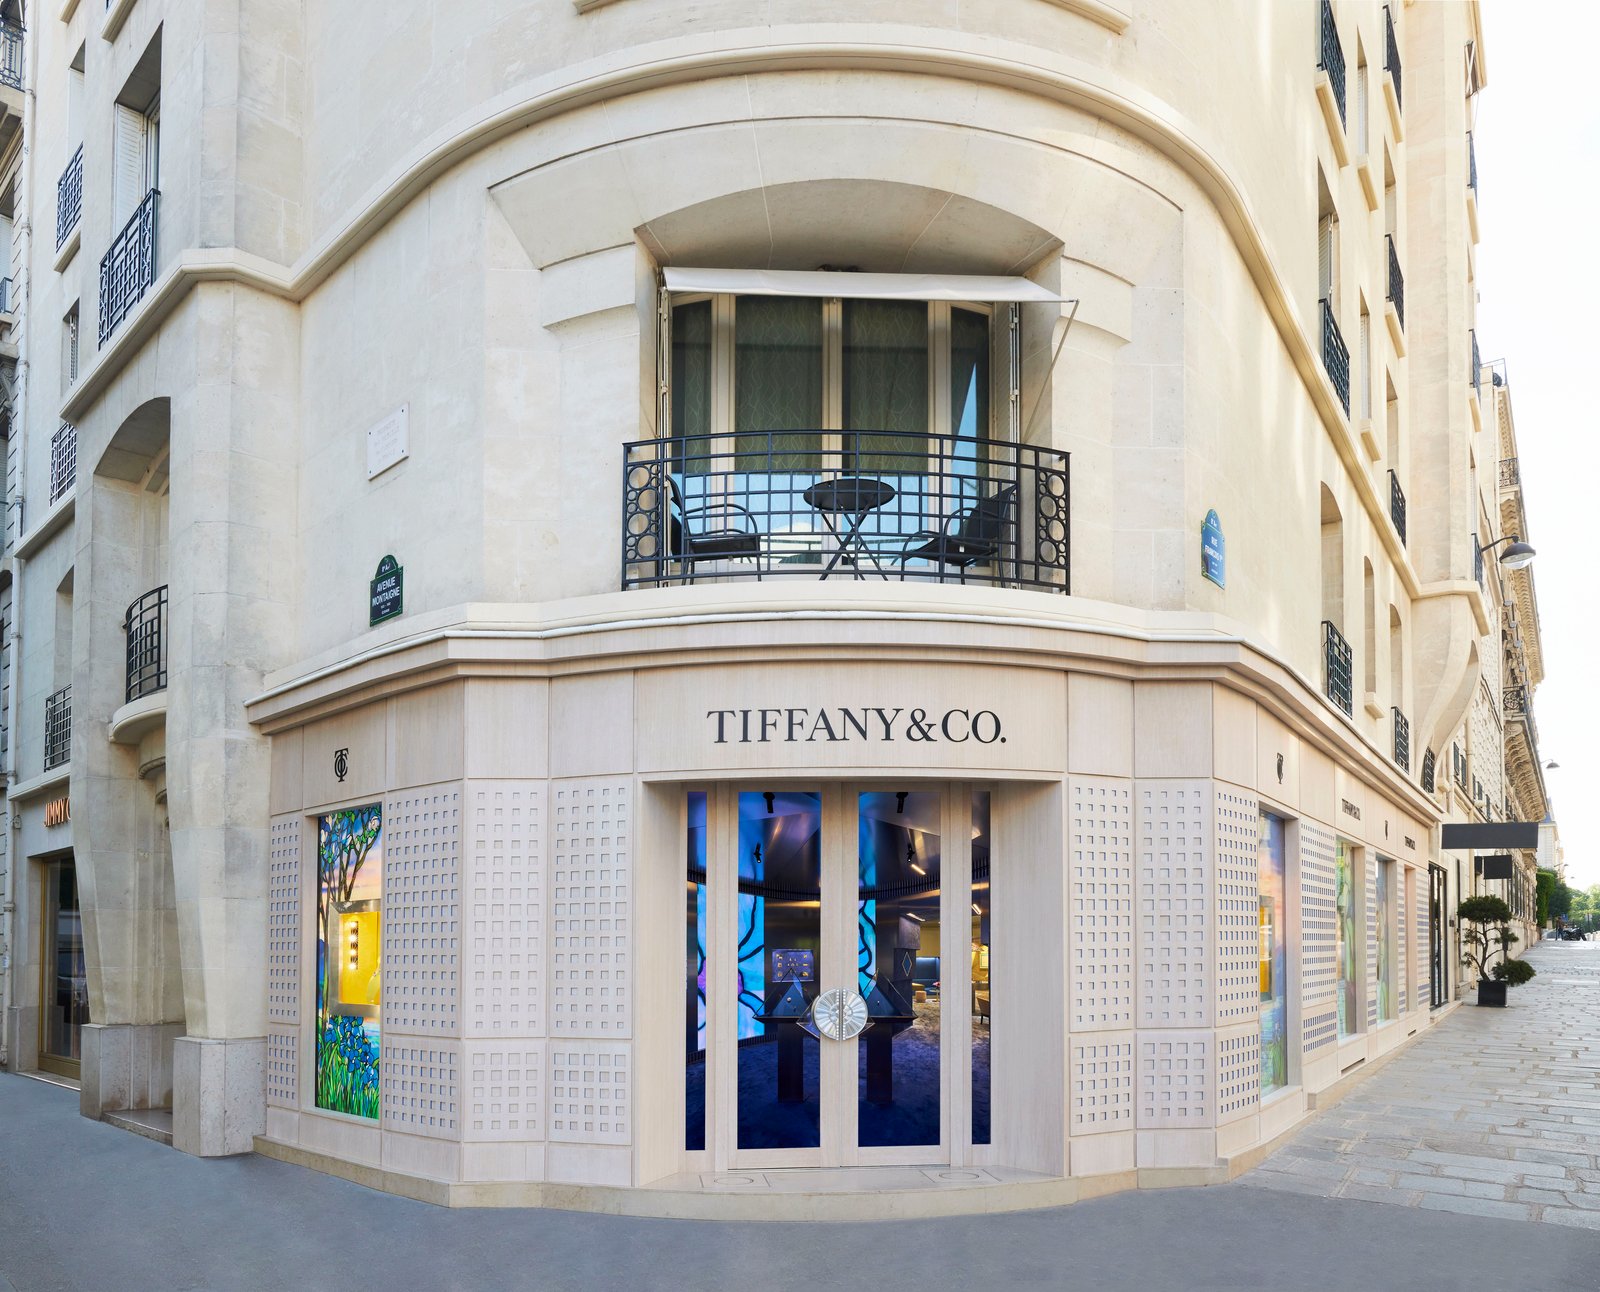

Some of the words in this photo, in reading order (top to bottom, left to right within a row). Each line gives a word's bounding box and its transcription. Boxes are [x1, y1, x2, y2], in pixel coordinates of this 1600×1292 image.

[376, 576, 396, 593] AVENUE
[371, 586, 400, 607] MONTAIGNE
[44, 798, 65, 827] JIMMY
